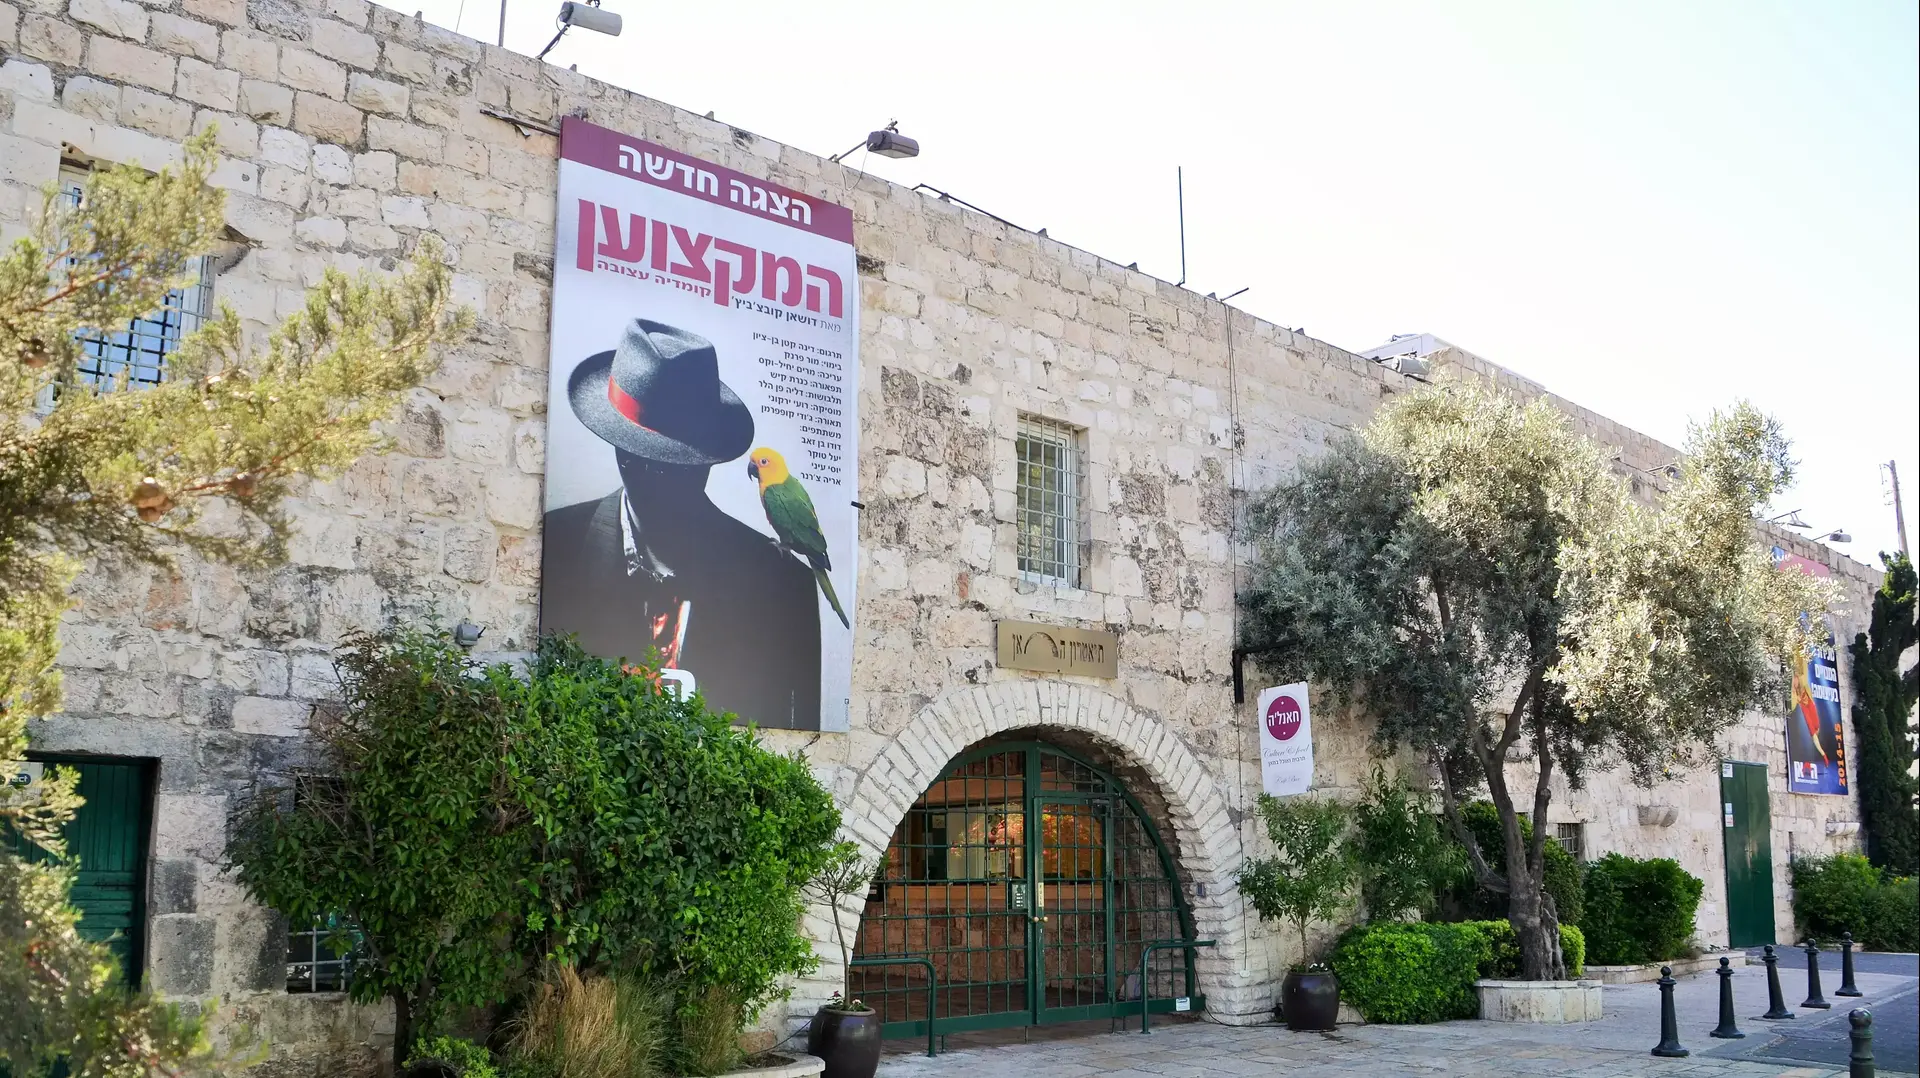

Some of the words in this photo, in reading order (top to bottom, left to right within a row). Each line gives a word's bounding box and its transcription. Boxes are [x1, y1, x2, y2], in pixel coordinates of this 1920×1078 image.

[619, 144, 719, 197] חדשה
[730, 178, 812, 226] הצגה
[576, 198, 843, 319] המקצוען
[597, 260, 650, 281] עצובה
[655, 274, 711, 297] קומדיה
[786, 311, 818, 328] דושאן
[820, 318, 841, 333] מאת
[781, 339, 796, 349] קטן
[798, 343, 815, 353] דינה
[784, 351, 804, 362] פרנק
[817, 348, 842, 359] תרגום:
[806, 356, 819, 366] מור
[821, 361, 842, 371] בימוי:
[770, 371, 787, 382] קיש
[796, 366, 815, 376] מרים
[817, 371, 842, 382] עריכה:
[758, 379, 773, 390] הלר
[789, 376, 808, 386] כנרת
[775, 384, 784, 393] פן
[786, 386, 803, 396] דליה
[810, 381, 842, 393] תפאורה:
[768, 394, 791, 405] ירקוני
[805, 391, 842, 405] תלבושות:
[793, 400, 809, 409] רועי
[810, 404, 842, 416] מוסיקה:
[761, 405, 795, 419] קופפרמן
[814, 417, 842, 428] תאורה:
[800, 425, 842, 439] משתתפים:
[801, 436, 816, 446] זאב
[817, 440, 825, 448] בן
[827, 442, 842, 451] דודו
[828, 452, 842, 462] יעל
[828, 466, 842, 474] יוסי
[823, 476, 842, 486] אריה
[1834, 723, 1846, 787] 2014-15
